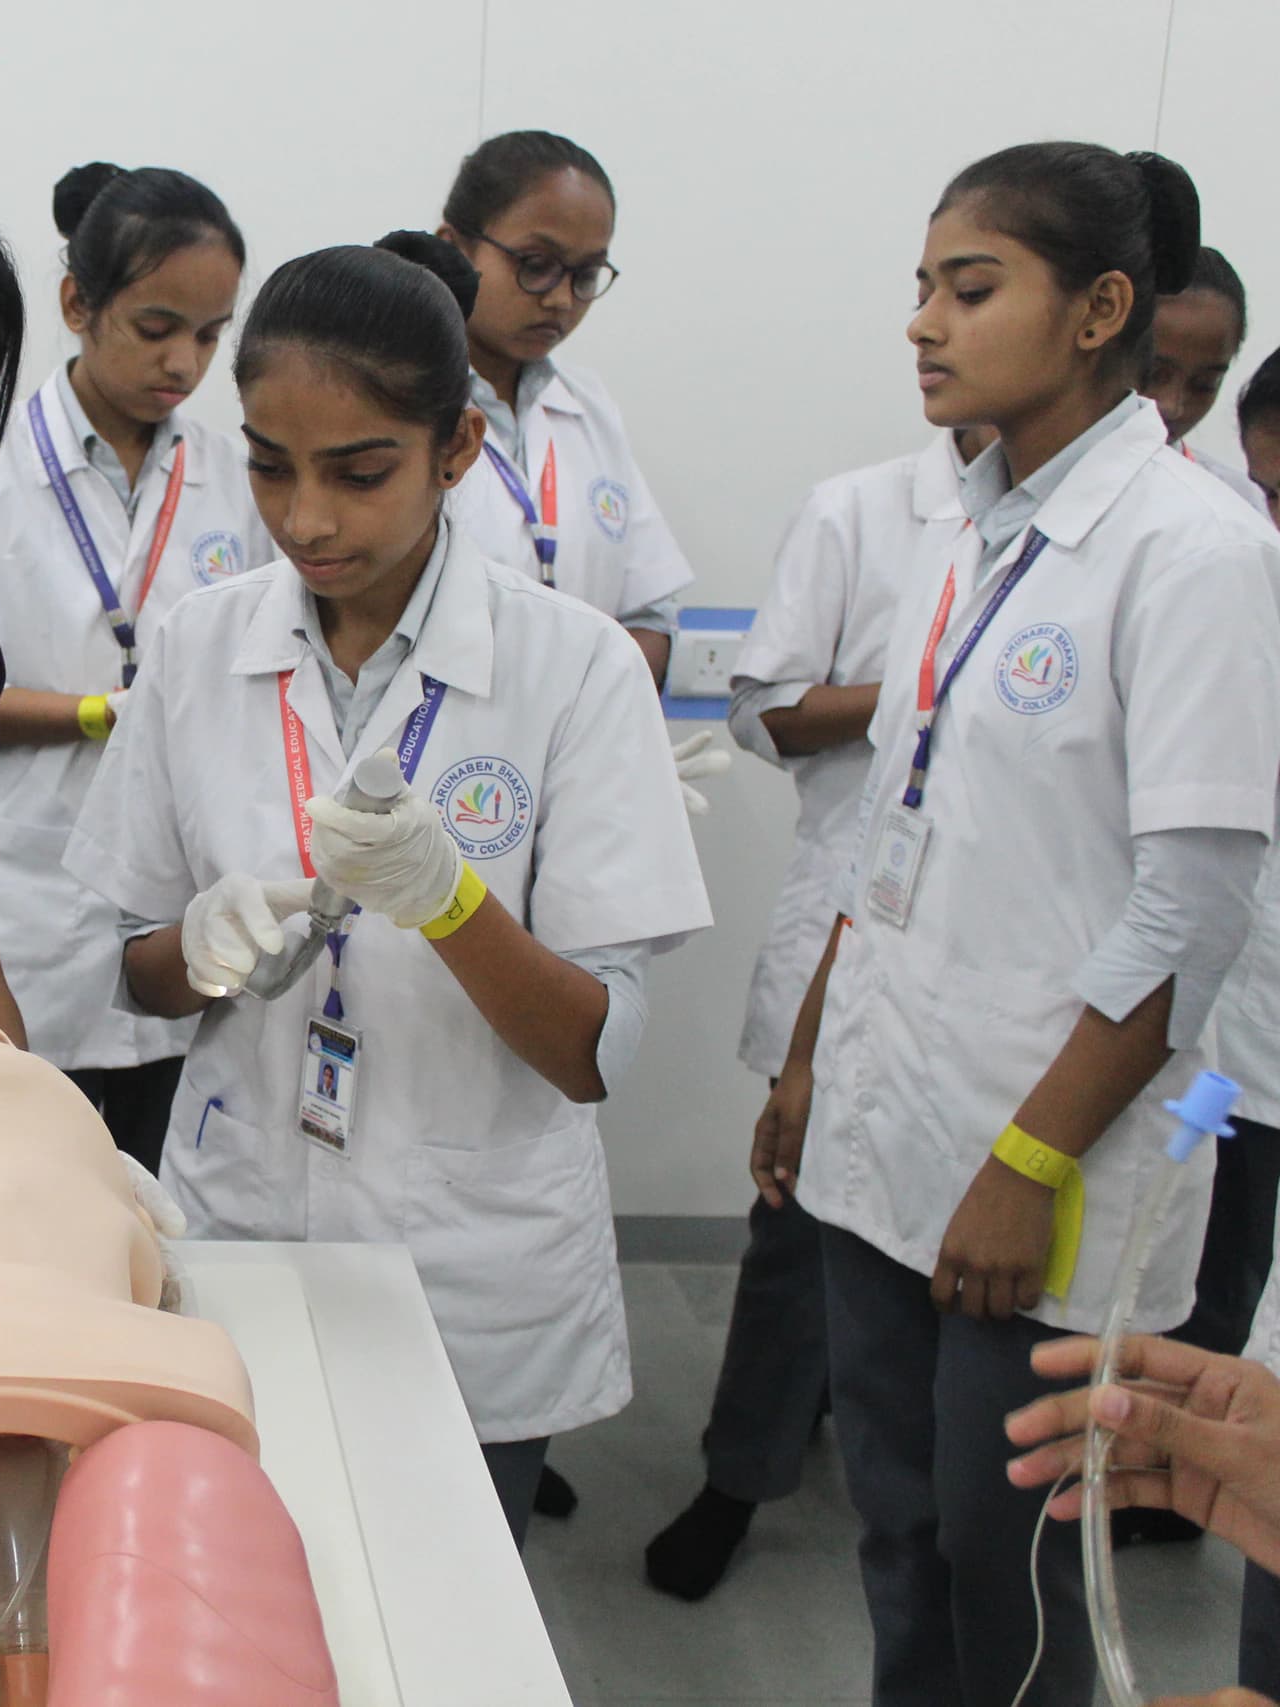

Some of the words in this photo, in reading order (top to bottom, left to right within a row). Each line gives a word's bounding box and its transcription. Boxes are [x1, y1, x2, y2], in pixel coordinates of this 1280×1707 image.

[435, 761, 493, 807] ARUNABEN
[498, 765, 528, 811] BHAKTA
[479, 821, 525, 855] COLLEGE
